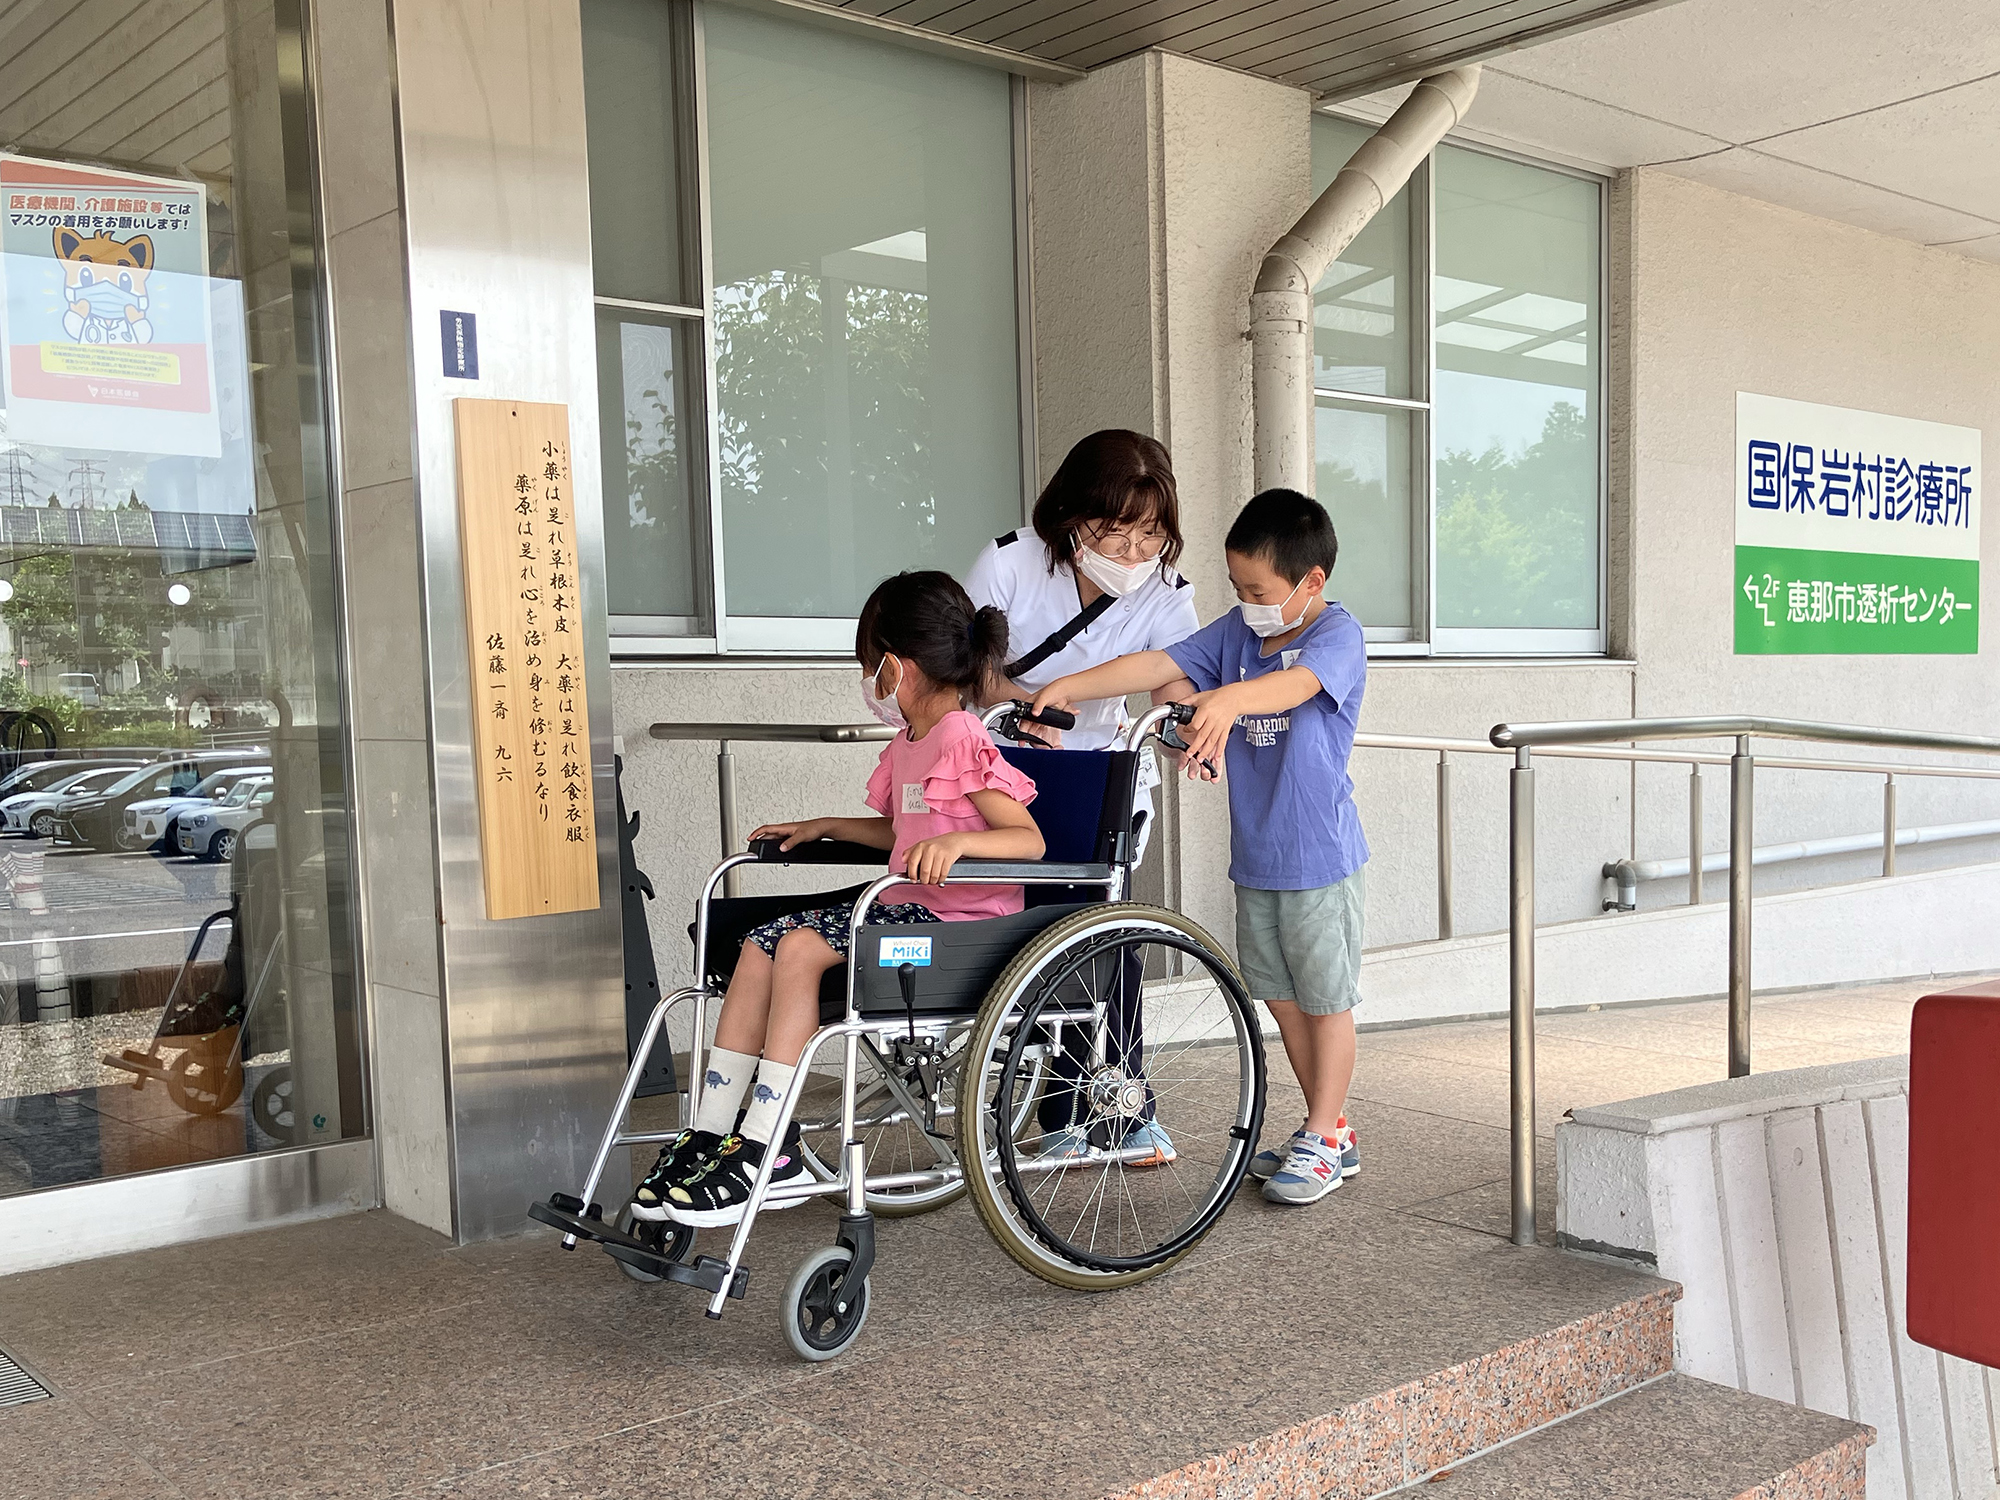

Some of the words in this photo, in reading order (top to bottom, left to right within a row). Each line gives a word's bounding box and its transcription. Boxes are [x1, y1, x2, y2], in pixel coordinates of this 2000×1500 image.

[10, 195, 191, 215] 医療機関、介護施設等では
[1748, 439, 1972, 529] 国保岩村診療所
[1762, 573, 1780, 598] 2F
[1787, 579, 1972, 625] 恵那市透析センター
[495, 744, 513, 783] 九六
